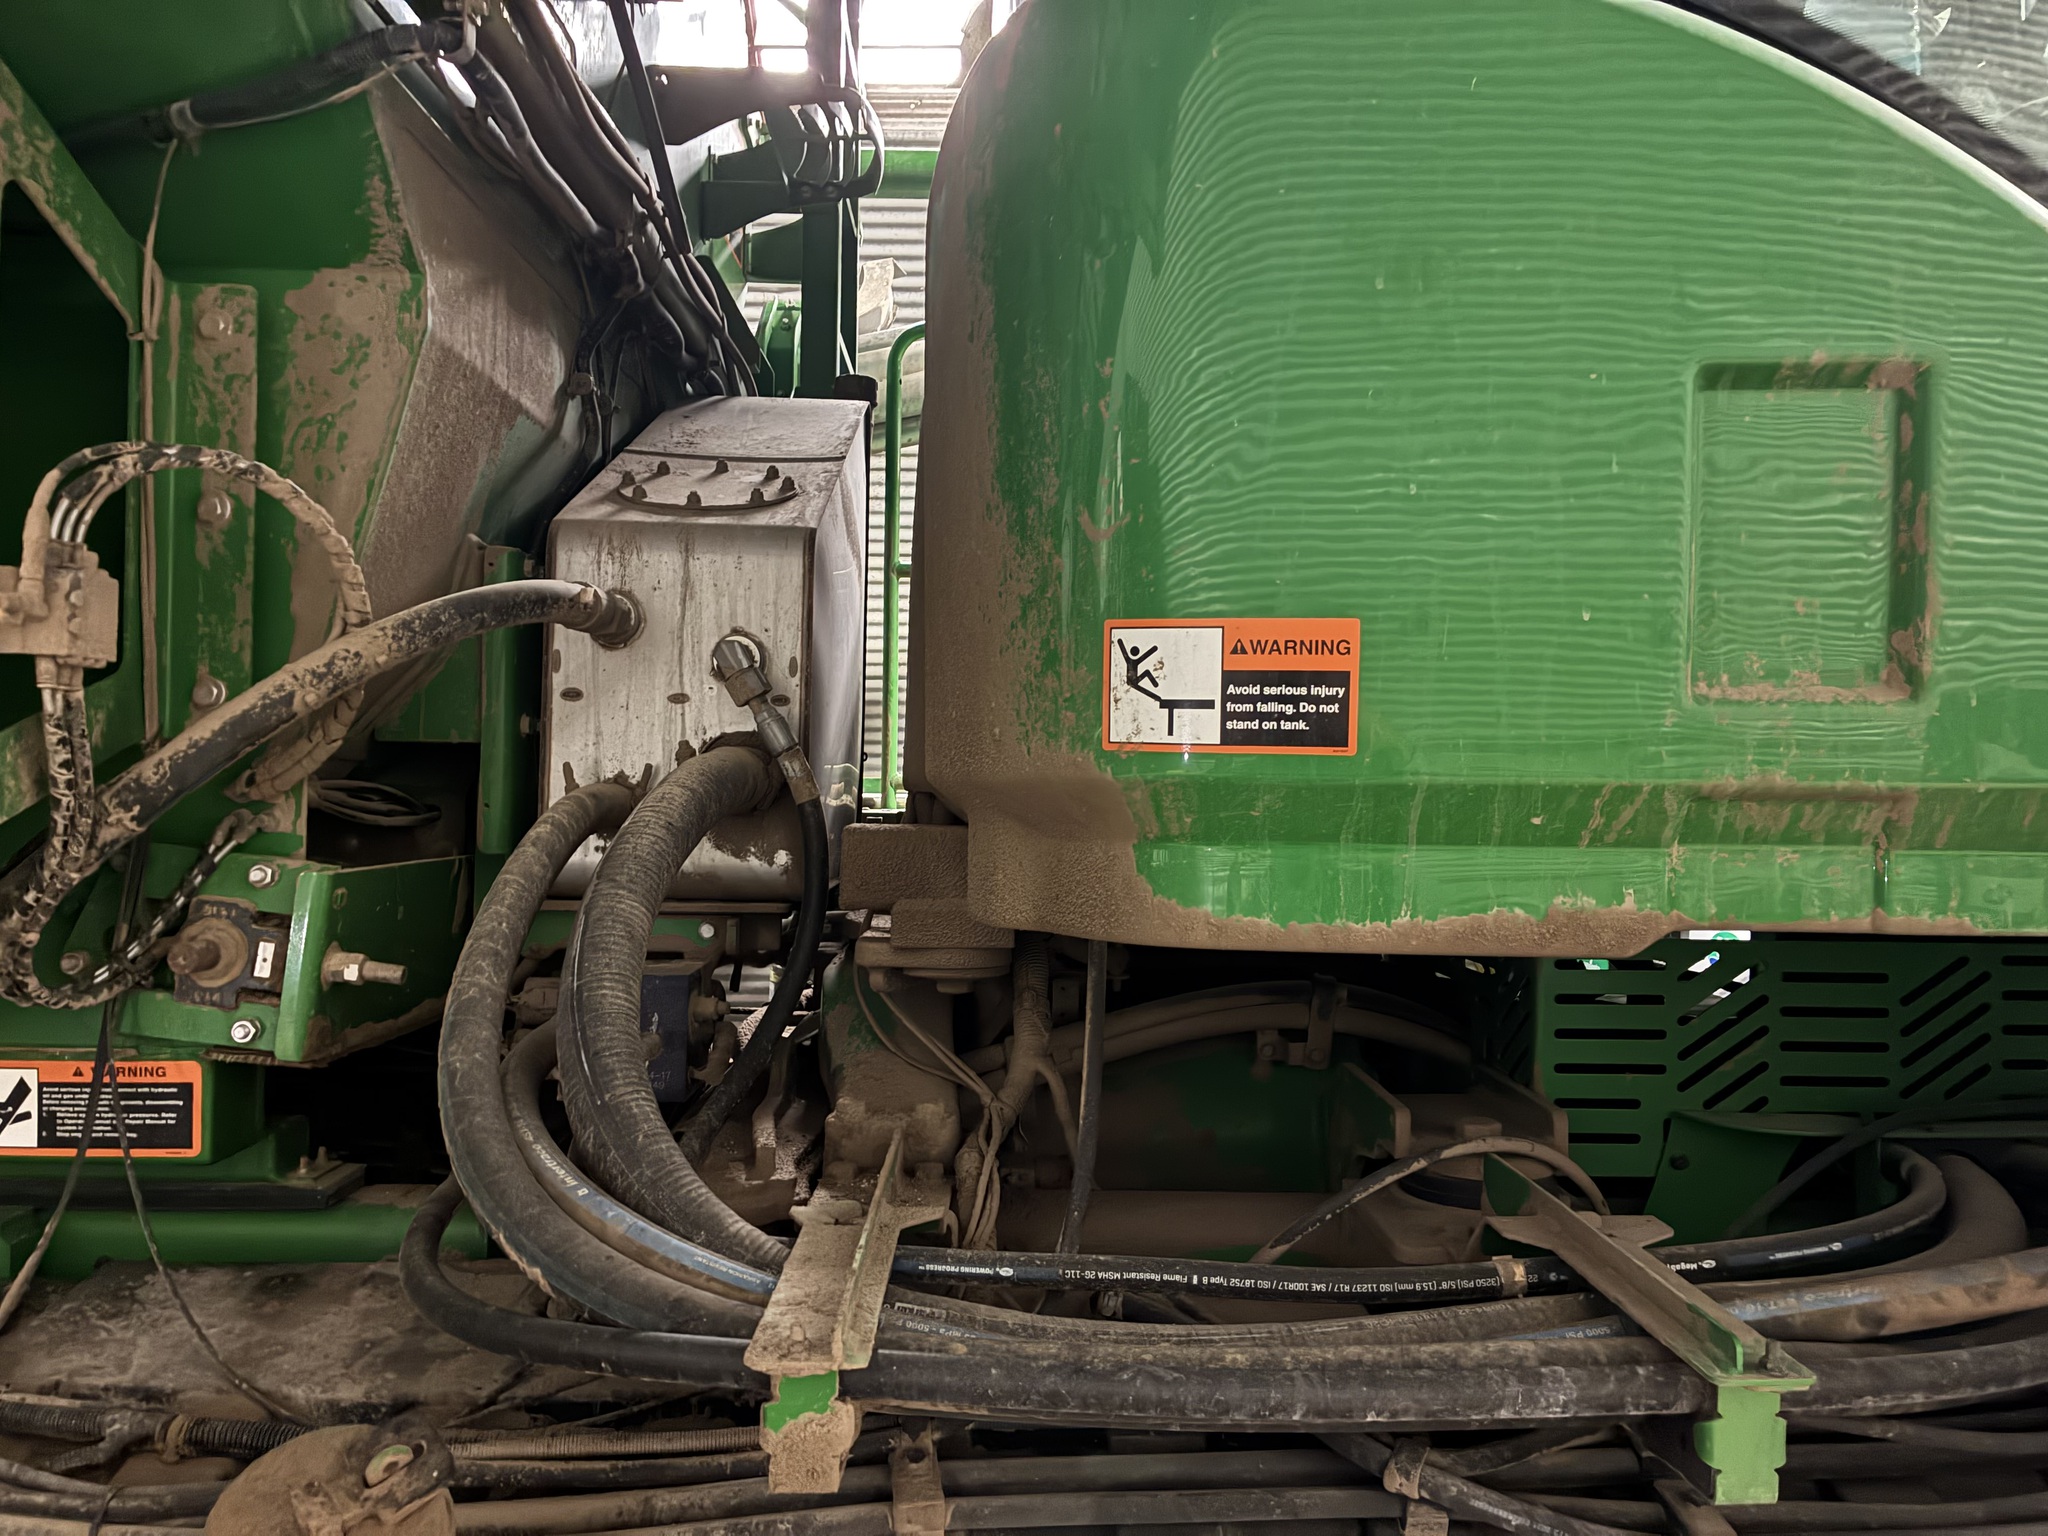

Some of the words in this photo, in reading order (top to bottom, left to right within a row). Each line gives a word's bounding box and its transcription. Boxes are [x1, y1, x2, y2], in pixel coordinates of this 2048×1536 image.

[1249, 639, 1351, 656] WARNING
[1226, 684, 1260, 695] Avoid
[1263, 684, 1308, 695] serious
[1310, 684, 1345, 698] injury
[1225, 701, 1254, 712] from
[1256, 702, 1297, 715] falling.
[1299, 702, 1316, 713] Do
[1319, 702, 1340, 713] not
[1225, 719, 1259, 729] stand
[1261, 720, 1277, 730] on
[1280, 719, 1310, 730] tank.
[960, 1266, 994, 1275] POWERING
[1098, 1271, 1121, 1280] MSHA
[1123, 1271, 1161, 1282] Resistant
[1162, 1273, 1188, 1283] Flame
[1202, 1276, 1209, 1285] B
[1210, 1276, 1228, 1286] Type
[1229, 1278, 1256, 1288] 18752
[1257, 1280, 1271, 1289] ISO
[1278, 1281, 1309, 1291] 100R17
[1311, 1283, 1327, 1292] SAE
[1334, 1284, 1350, 1292] R17
[1351, 1284, 1378, 1293] 11237
[1380, 1285, 1394, 1293] ISO
[1586, 1326, 1611, 1337] 5000
